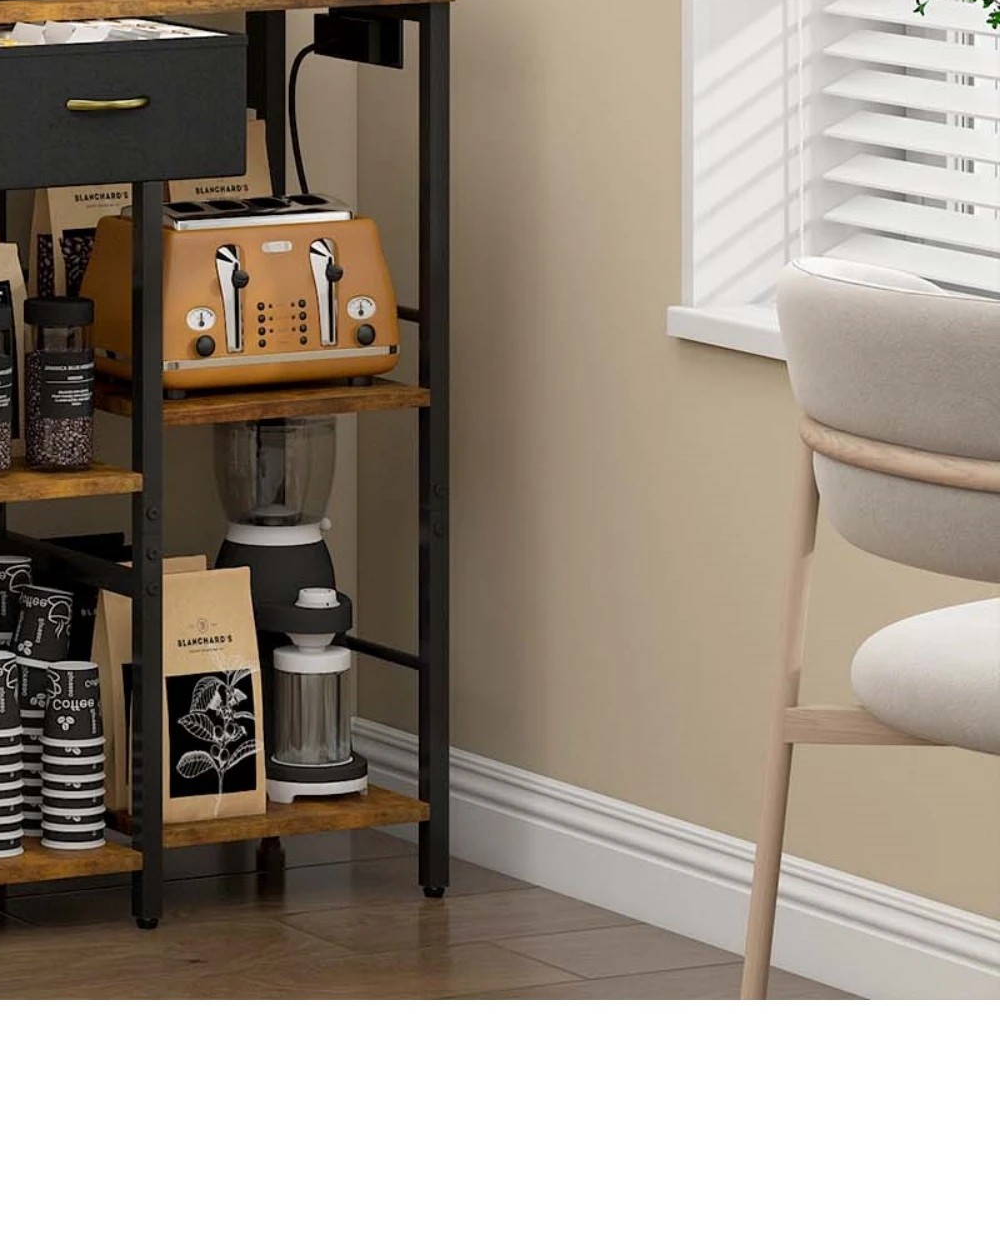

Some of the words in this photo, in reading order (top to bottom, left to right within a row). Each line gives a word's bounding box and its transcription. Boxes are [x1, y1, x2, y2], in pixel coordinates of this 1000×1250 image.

[195, 184, 249, 195] BLANCHARD'S
[74, 190, 129, 202] BLANCHARD'S
[177, 634, 233, 647] BLANCHARD'S
